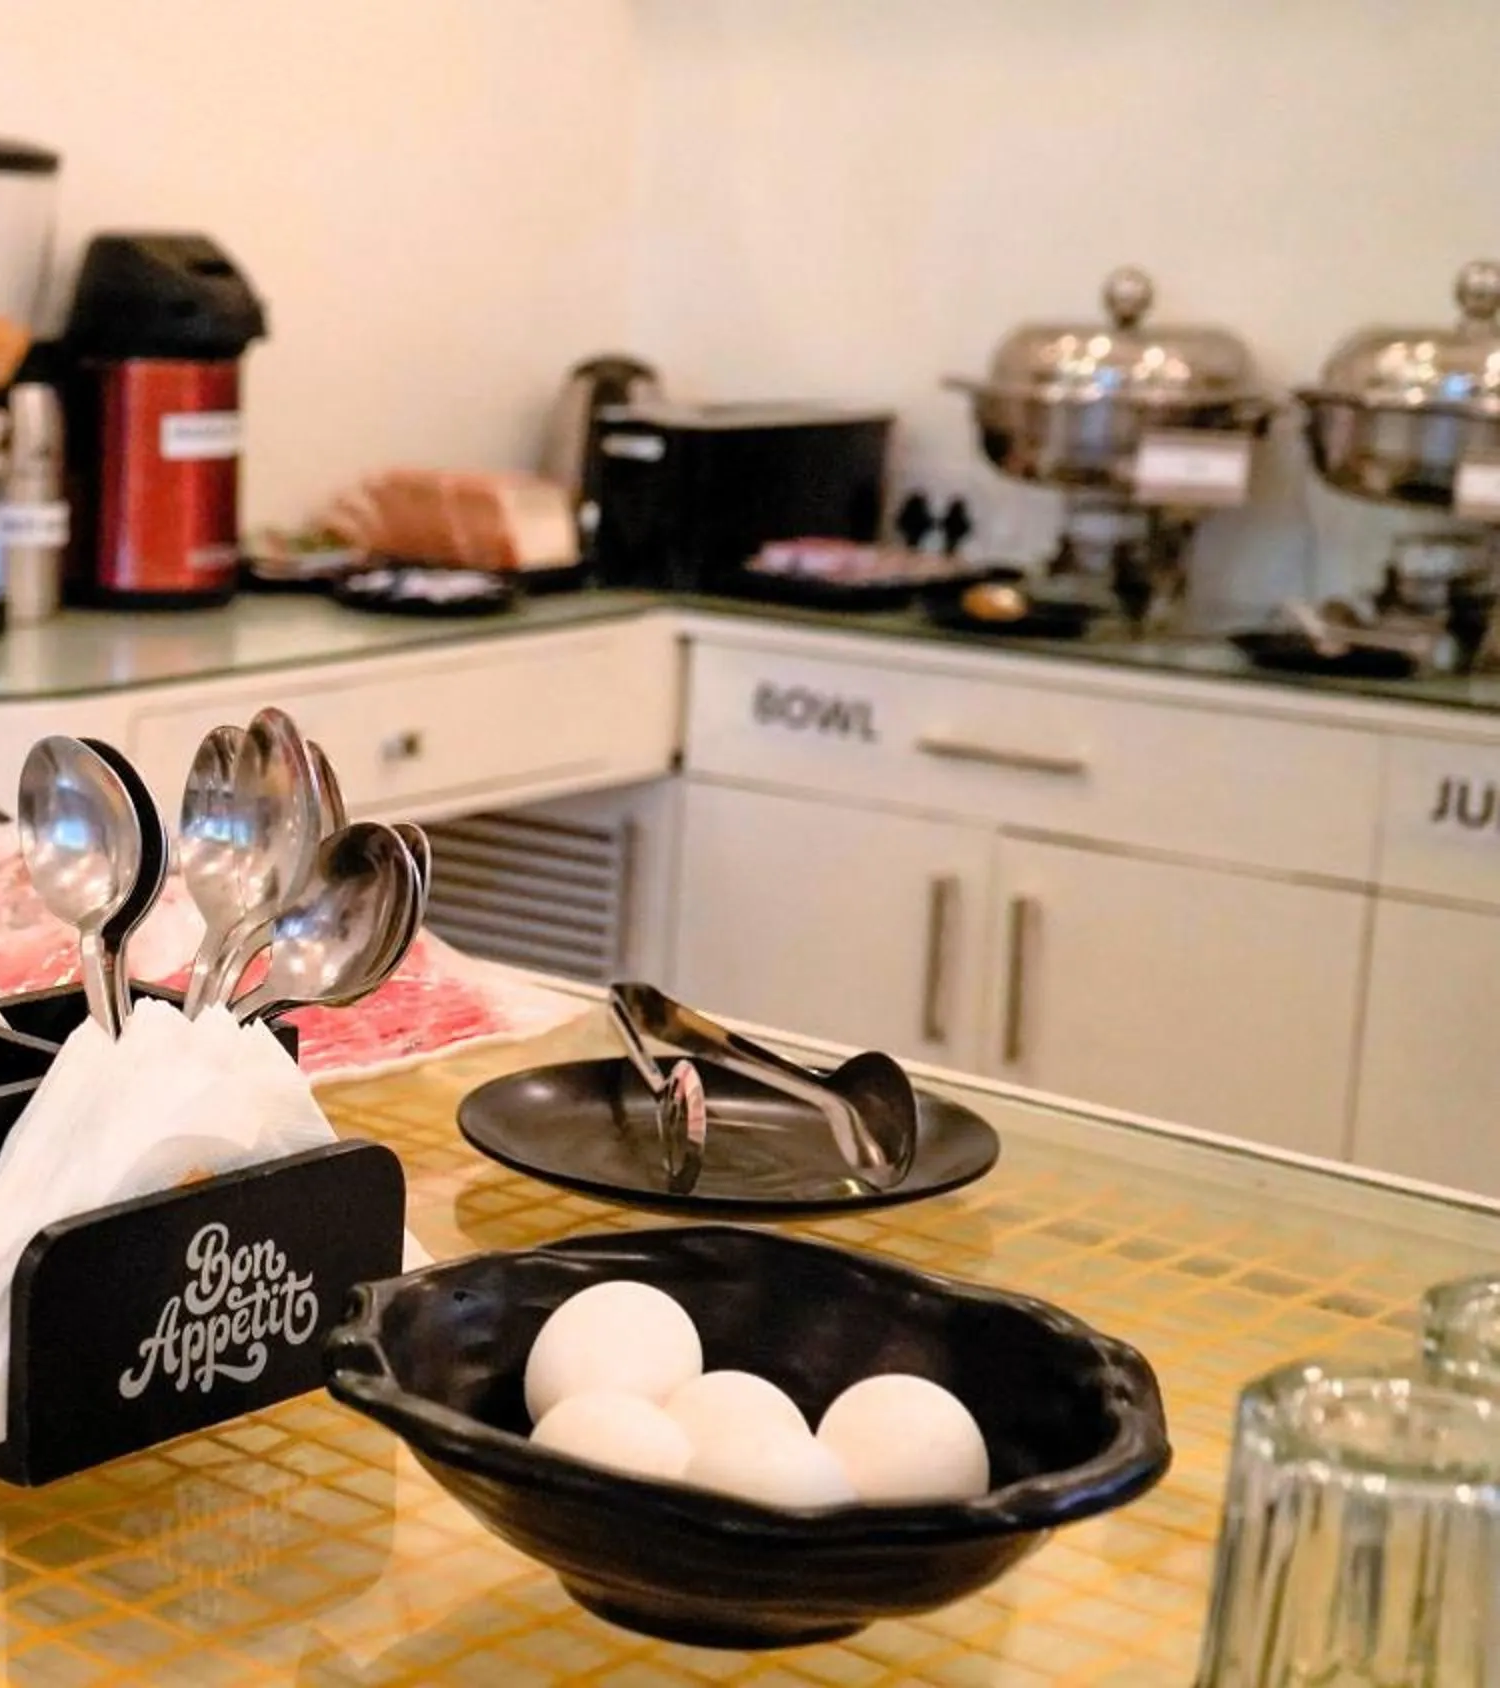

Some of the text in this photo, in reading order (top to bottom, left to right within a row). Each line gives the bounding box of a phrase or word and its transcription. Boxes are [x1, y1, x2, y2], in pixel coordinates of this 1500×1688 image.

[752, 680, 881, 744] BOWL
[1430, 775, 1500, 831] JU
[185, 1222, 286, 1314] Bon
[119, 1271, 319, 1398] Appetit
